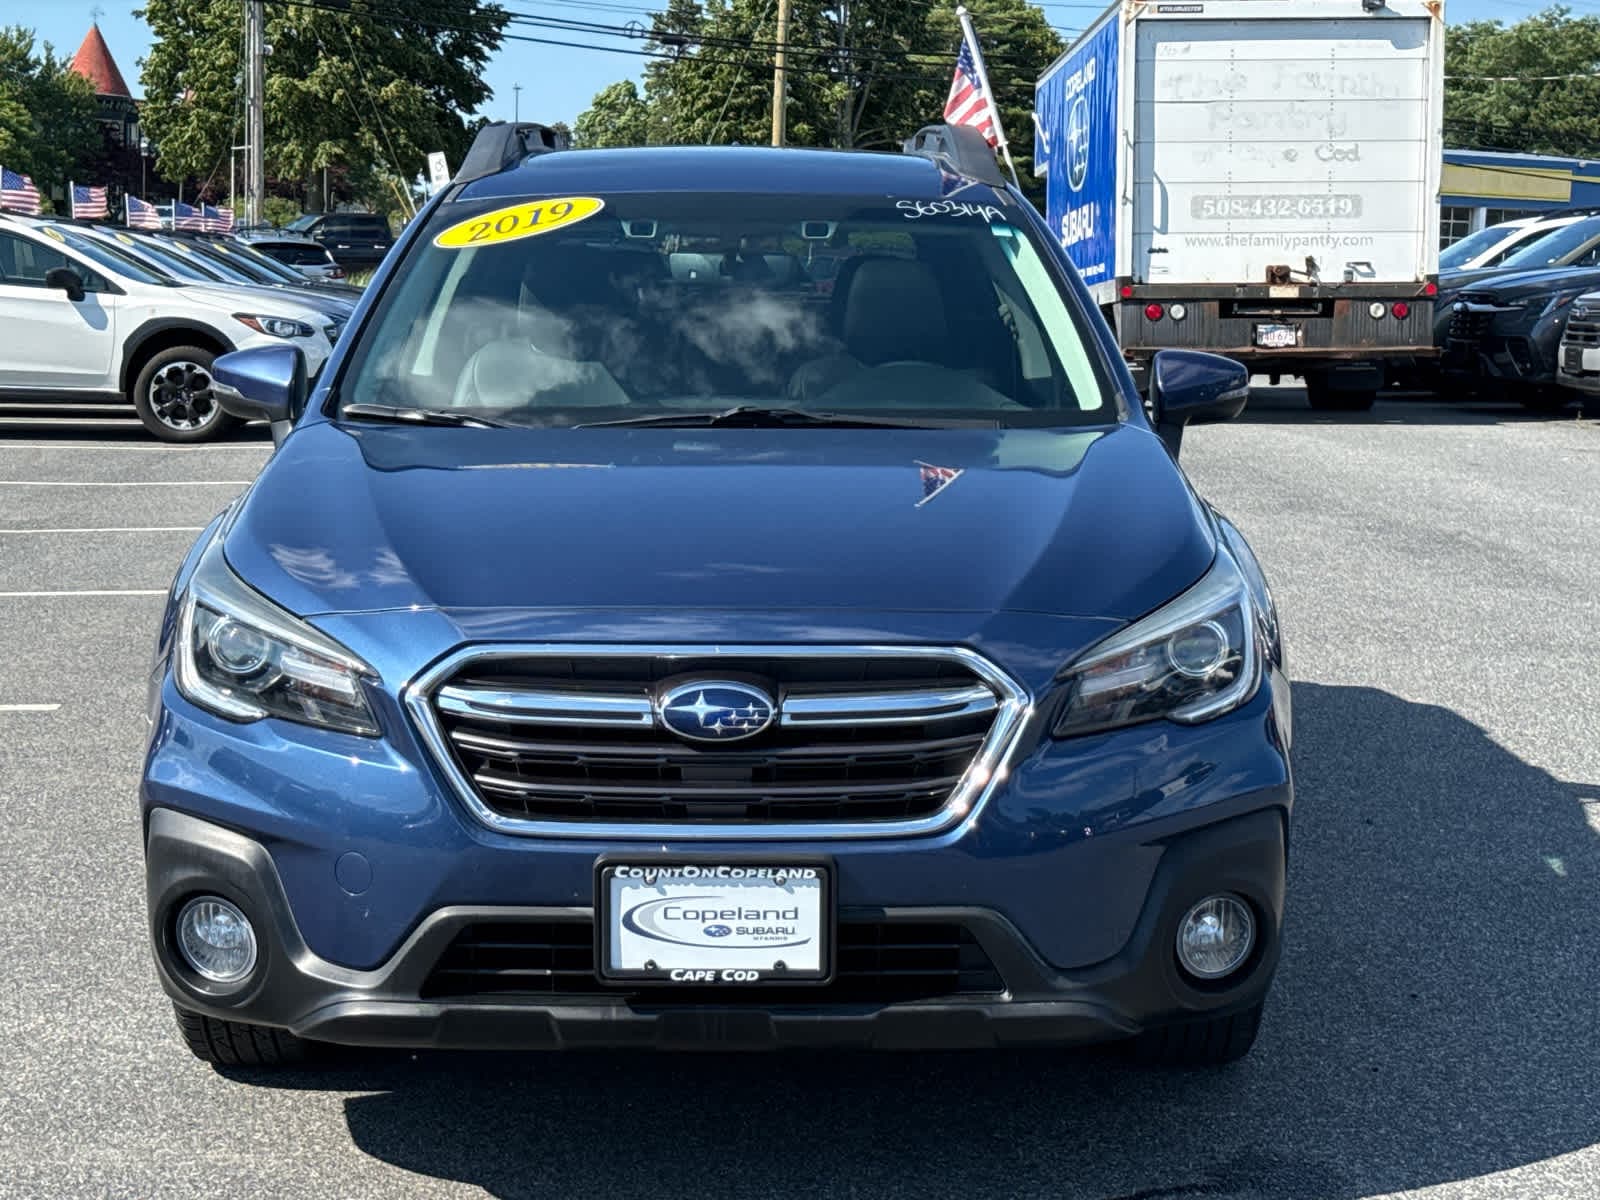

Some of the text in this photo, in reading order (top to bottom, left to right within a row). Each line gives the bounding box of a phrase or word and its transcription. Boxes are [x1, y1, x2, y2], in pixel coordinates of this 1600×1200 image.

[1065, 57, 1095, 101] COPELAND
[1315, 143, 1361, 163] Cod
[1202, 198, 1353, 217] 508-432-6519
[467, 202, 575, 242] 2019
[1061, 201, 1094, 249] SUBARU
[663, 906, 799, 924] Copeland
[735, 926, 796, 936] SUBARU
[670, 968, 760, 982] CAPE COD
